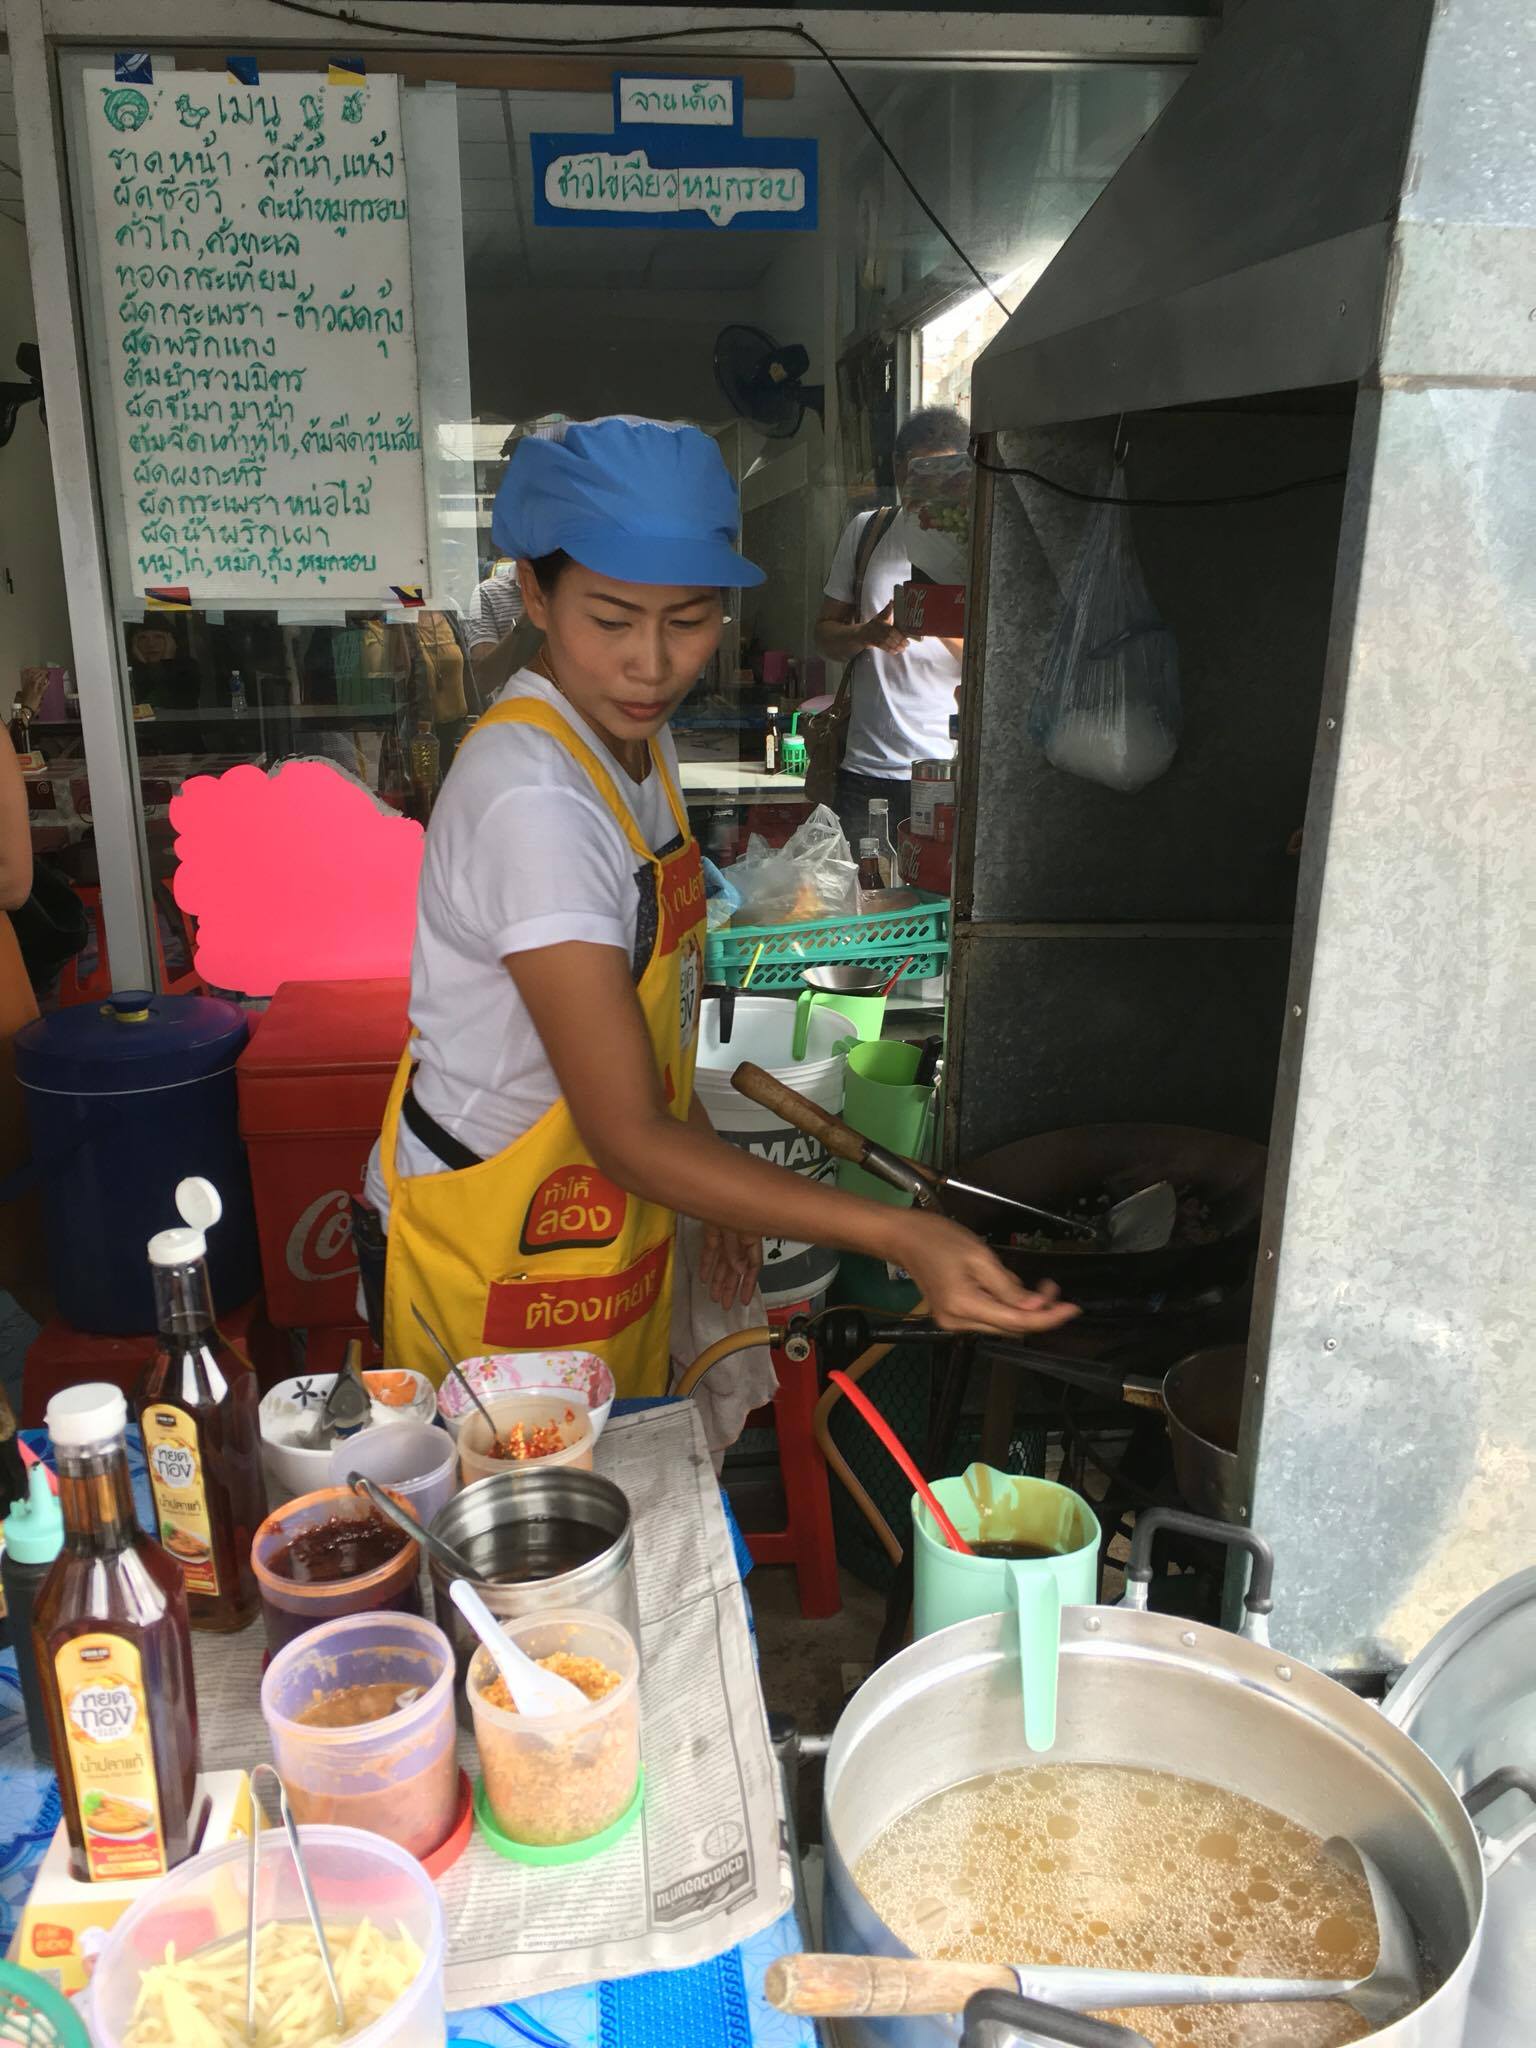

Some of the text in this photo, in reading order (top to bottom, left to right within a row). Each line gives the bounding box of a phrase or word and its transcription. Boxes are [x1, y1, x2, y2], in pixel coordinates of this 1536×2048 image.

[630, 82, 726, 112] จานเด็ด
[218, 94, 281, 143] เมนู
[108, 130, 231, 177] ราดหน้า
[258, 186, 406, 237] คะน้าหมูกรอบ
[115, 255, 296, 291] ทอดกระเทียม
[122, 326, 276, 357] ผัดพริกแกง
[123, 357, 307, 392] ต้มยำรวมมิตร
[544, 1175, 592, 1205] ท้าให้
[536, 1205, 612, 1236] ลอง
[158, 1447, 188, 1463] หยด
[158, 1460, 191, 1478] ทอง
[82, 1691, 127, 1708] หยด
[80, 1706, 132, 1728] ทอง
